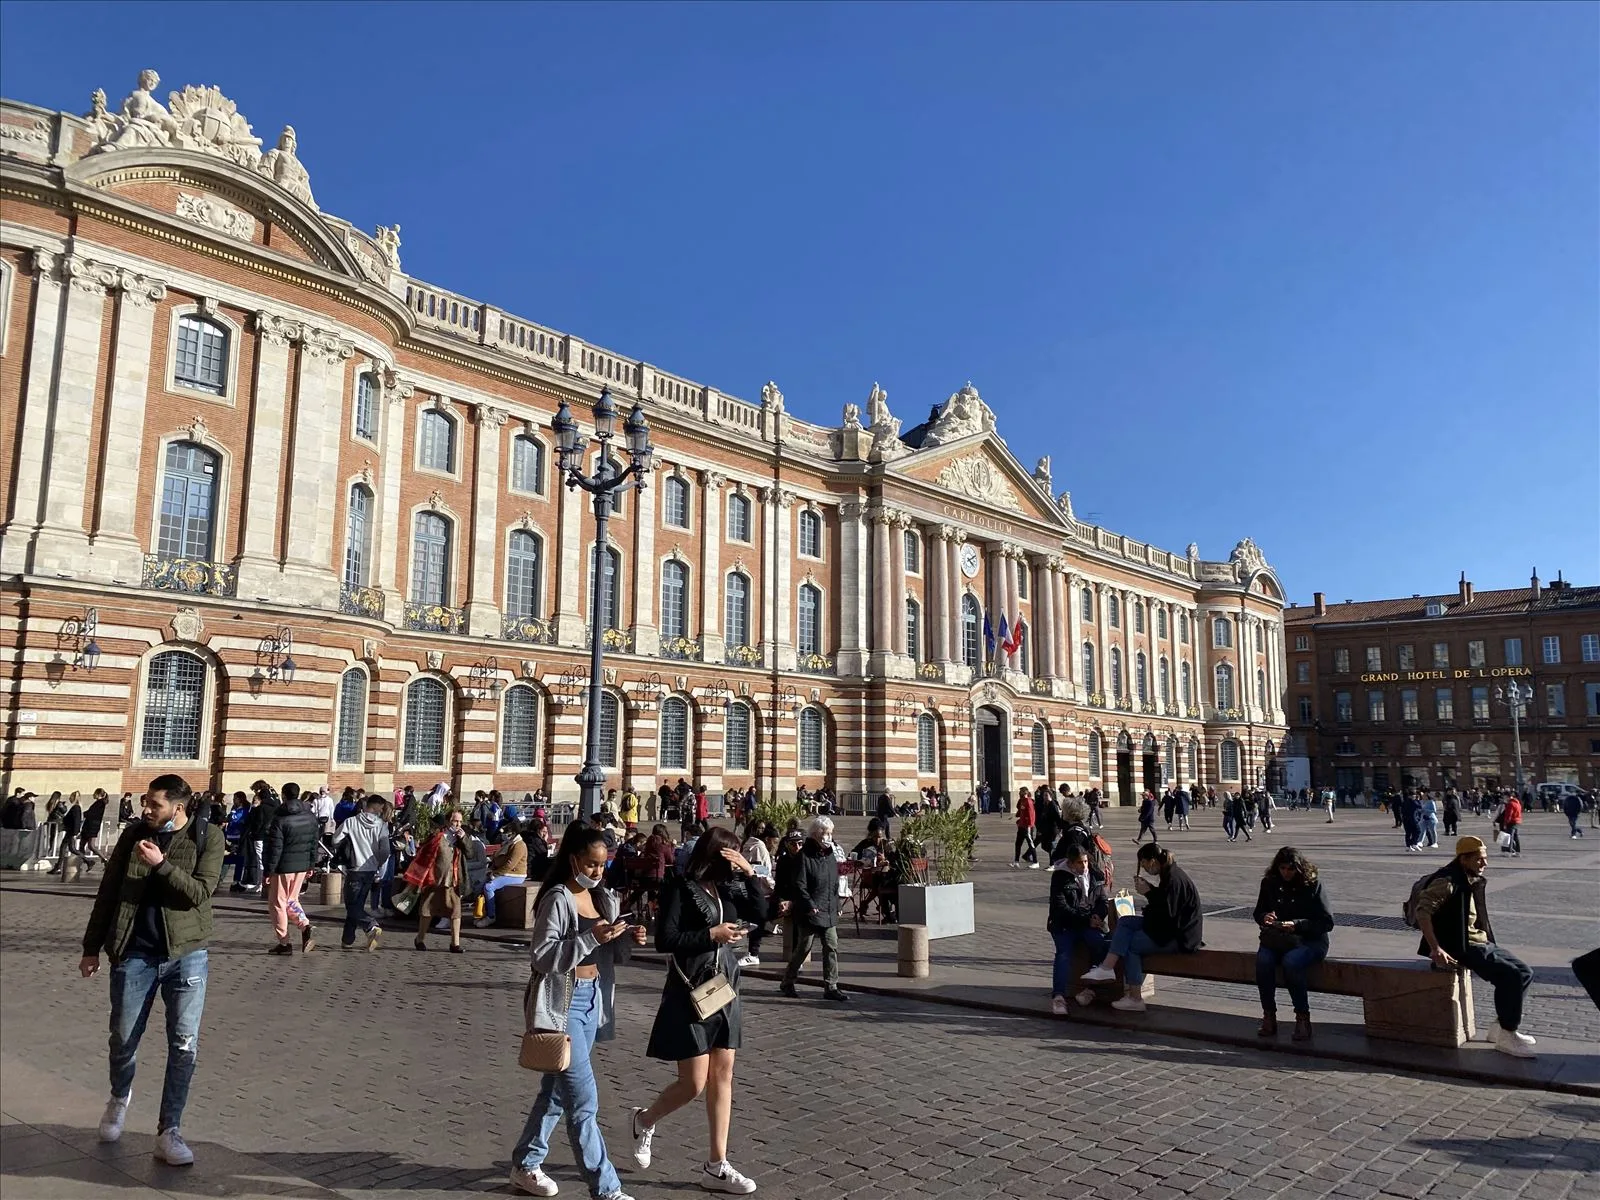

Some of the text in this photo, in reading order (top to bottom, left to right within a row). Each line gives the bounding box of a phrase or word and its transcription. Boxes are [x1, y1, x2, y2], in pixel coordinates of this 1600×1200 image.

[943, 505, 1012, 534] CAPITOLIUM
[1360, 673, 1399, 682] GRAND
[1408, 671, 1446, 680] HOTEL
[1454, 670, 1470, 678] DE
